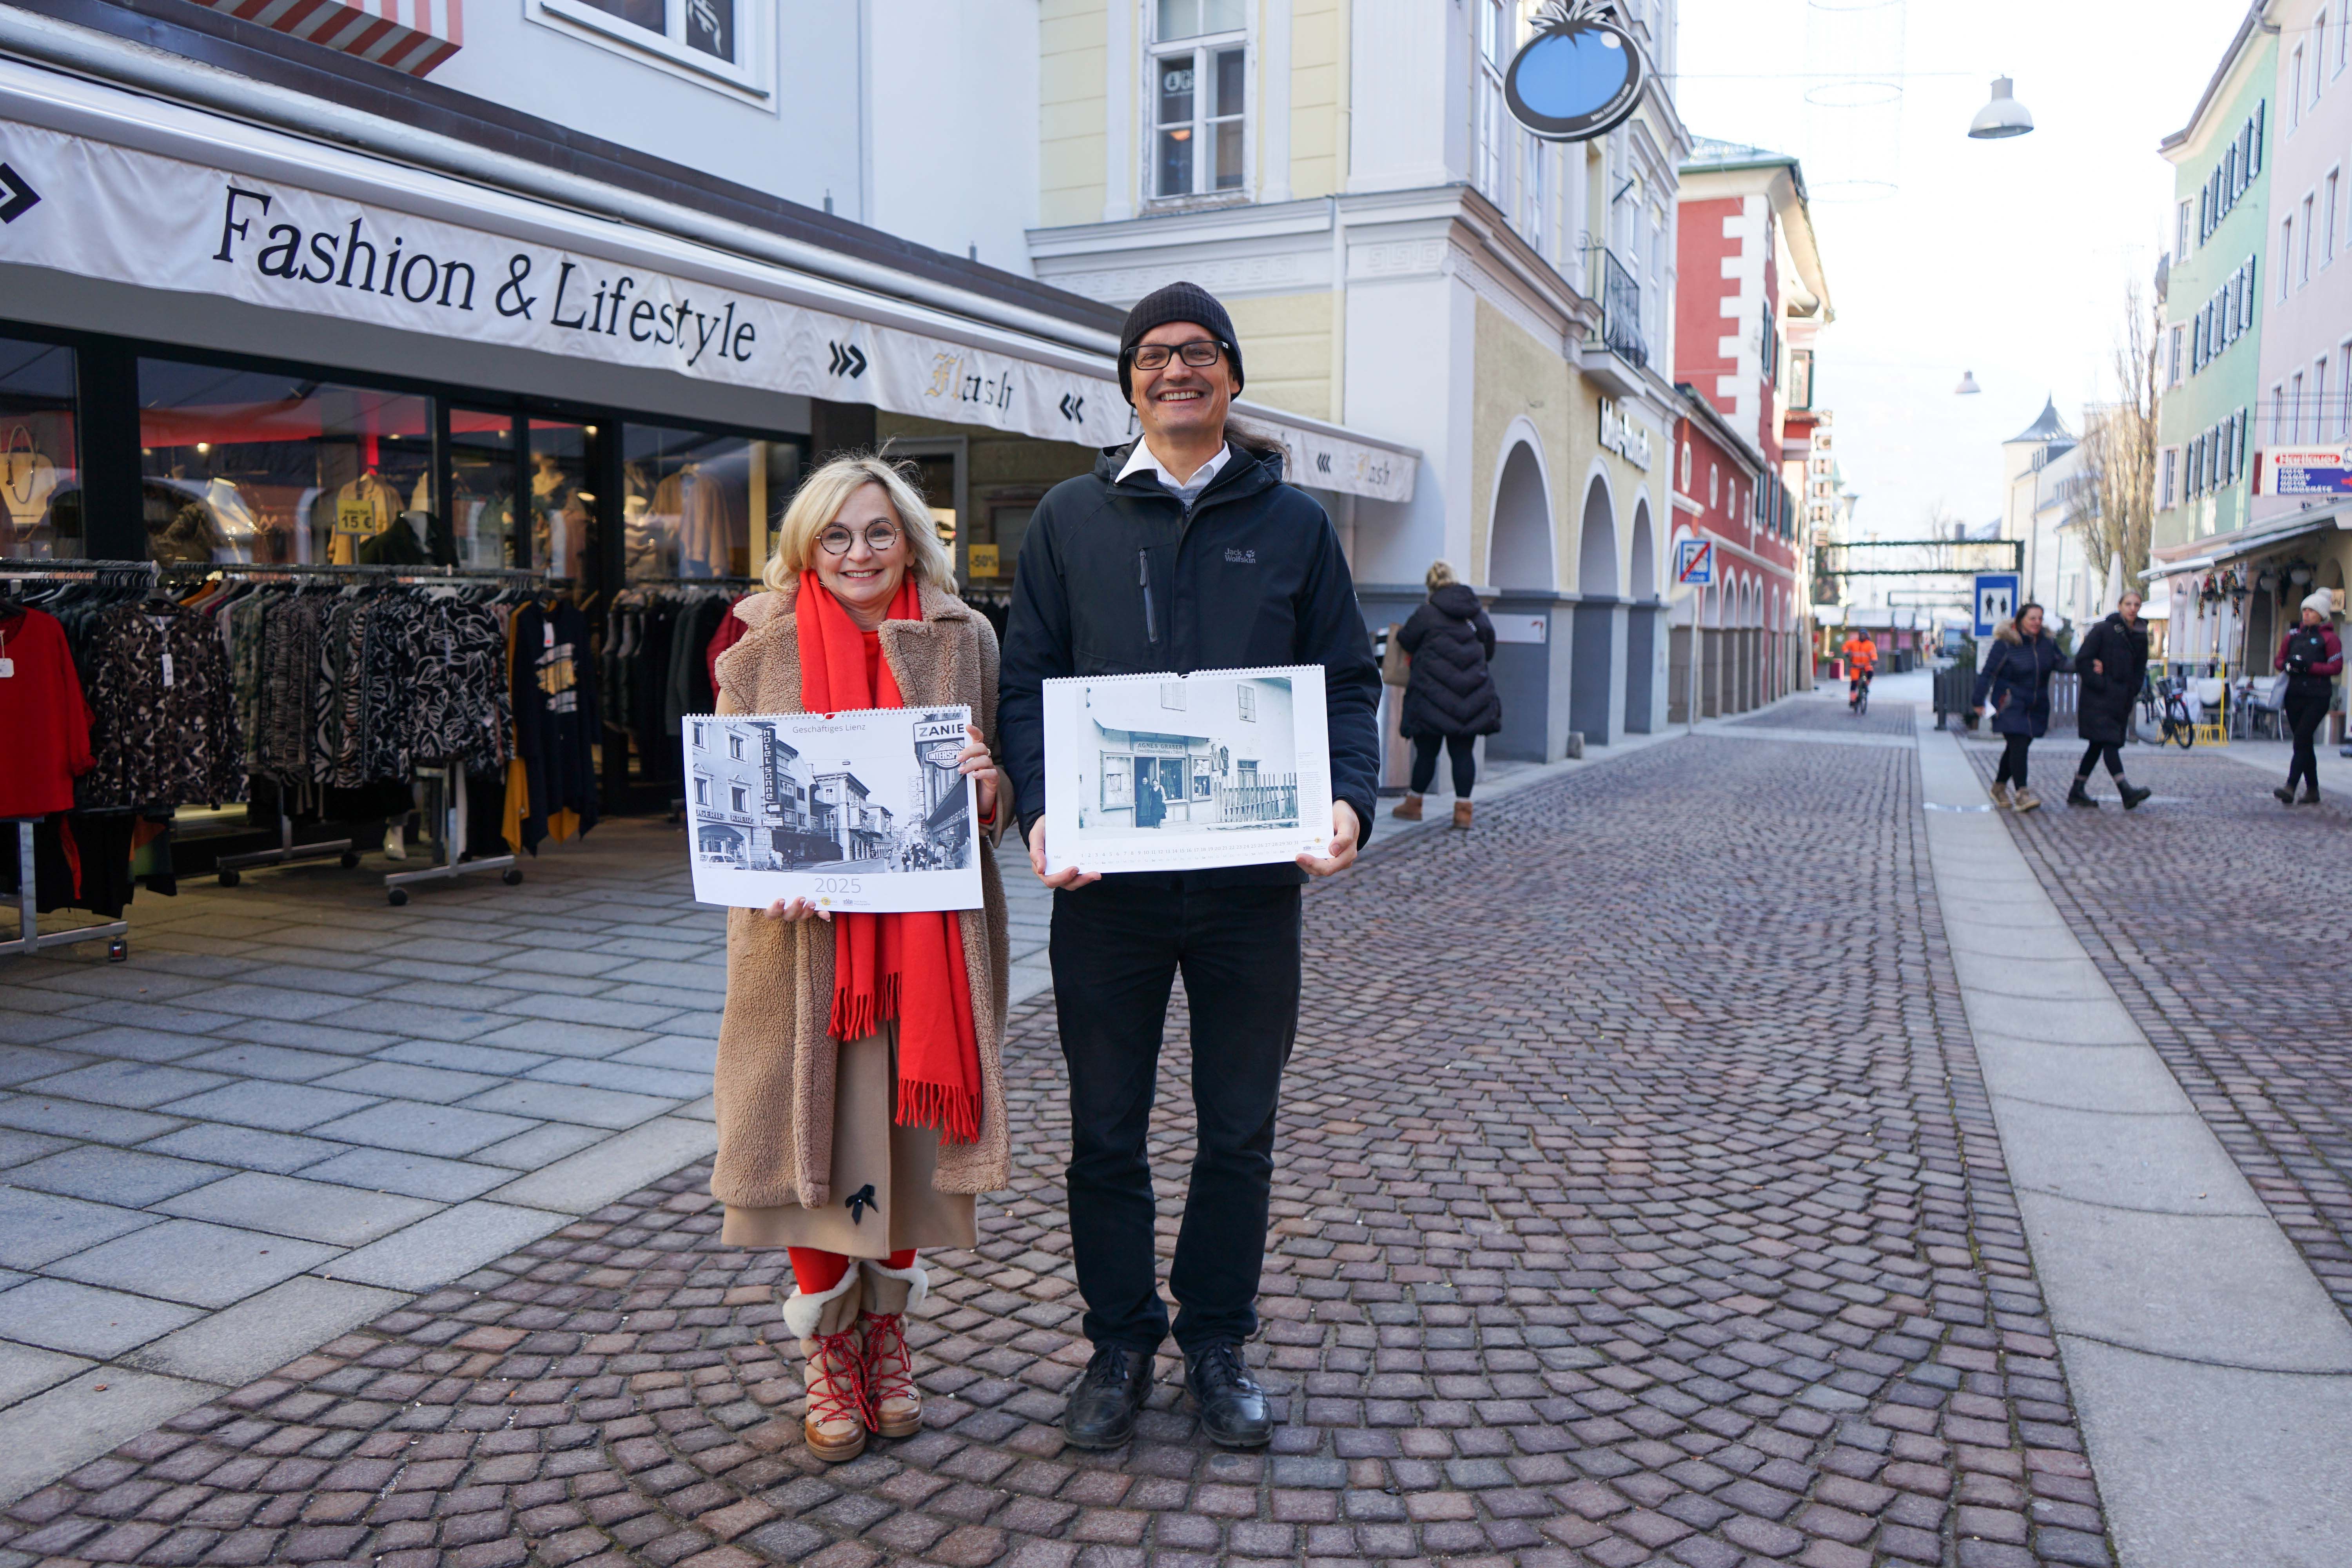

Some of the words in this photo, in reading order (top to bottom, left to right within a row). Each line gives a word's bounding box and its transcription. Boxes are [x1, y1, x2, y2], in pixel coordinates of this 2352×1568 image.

[213, 185, 475, 310] Fashion
[495, 254, 537, 320] &
[551, 262, 755, 367] Lifestyle
[924, 353, 1013, 424] Flash
[1356, 453, 1390, 486] Flash
[342, 515, 359, 528] 15
[364, 516, 372, 529] €
[971, 554, 998, 568] -50%
[1224, 555, 1256, 563] Wolfskin
[793, 725, 843, 733] Geschäftiges
[919, 724, 964, 737] ZANIE
[731, 815, 754, 823] KREUZ
[815, 878, 861, 893] 2025
